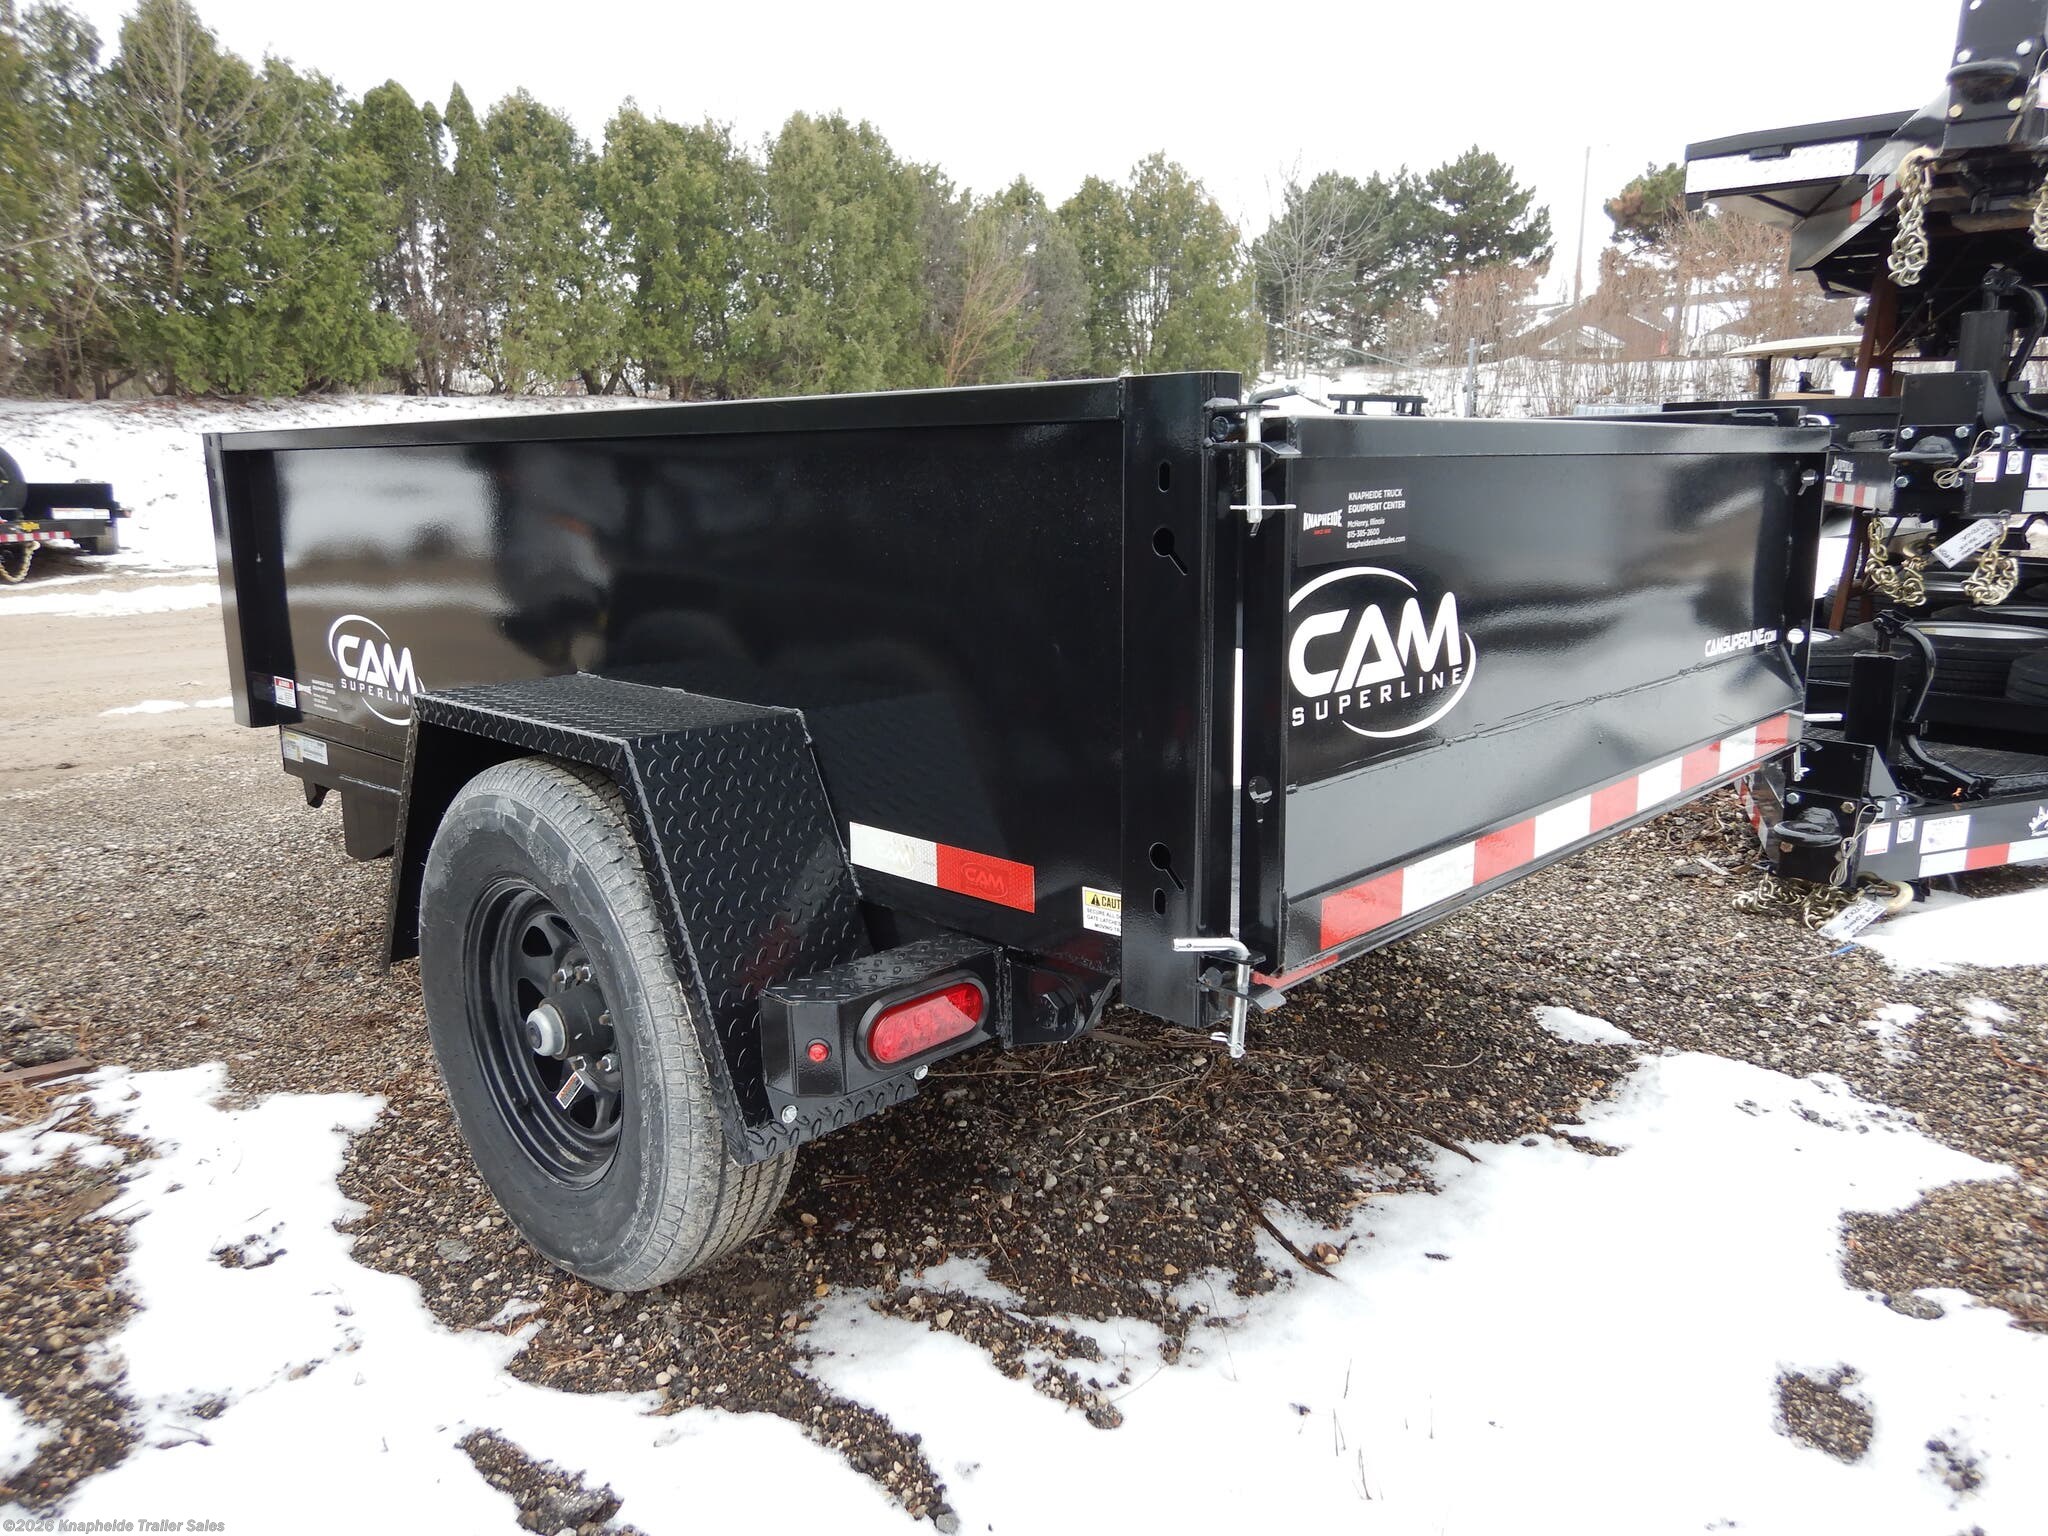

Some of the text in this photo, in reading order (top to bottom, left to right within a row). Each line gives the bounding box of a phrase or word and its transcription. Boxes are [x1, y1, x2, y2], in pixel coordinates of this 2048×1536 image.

[1347, 500, 1406, 514] EQUIPMENT CENTER
[1348, 488, 1403, 500] KNAPHEIDE TRUCK
[1303, 509, 1343, 531] KNAPHEIDE
[1289, 591, 1463, 698] CAM
[337, 634, 418, 695] CAM
[340, 678, 410, 706] SUPERLIN
[1291, 667, 1464, 727] SUPERLINE
[964, 867, 1006, 894] CAM
[1101, 895, 1121, 910] CAUT
